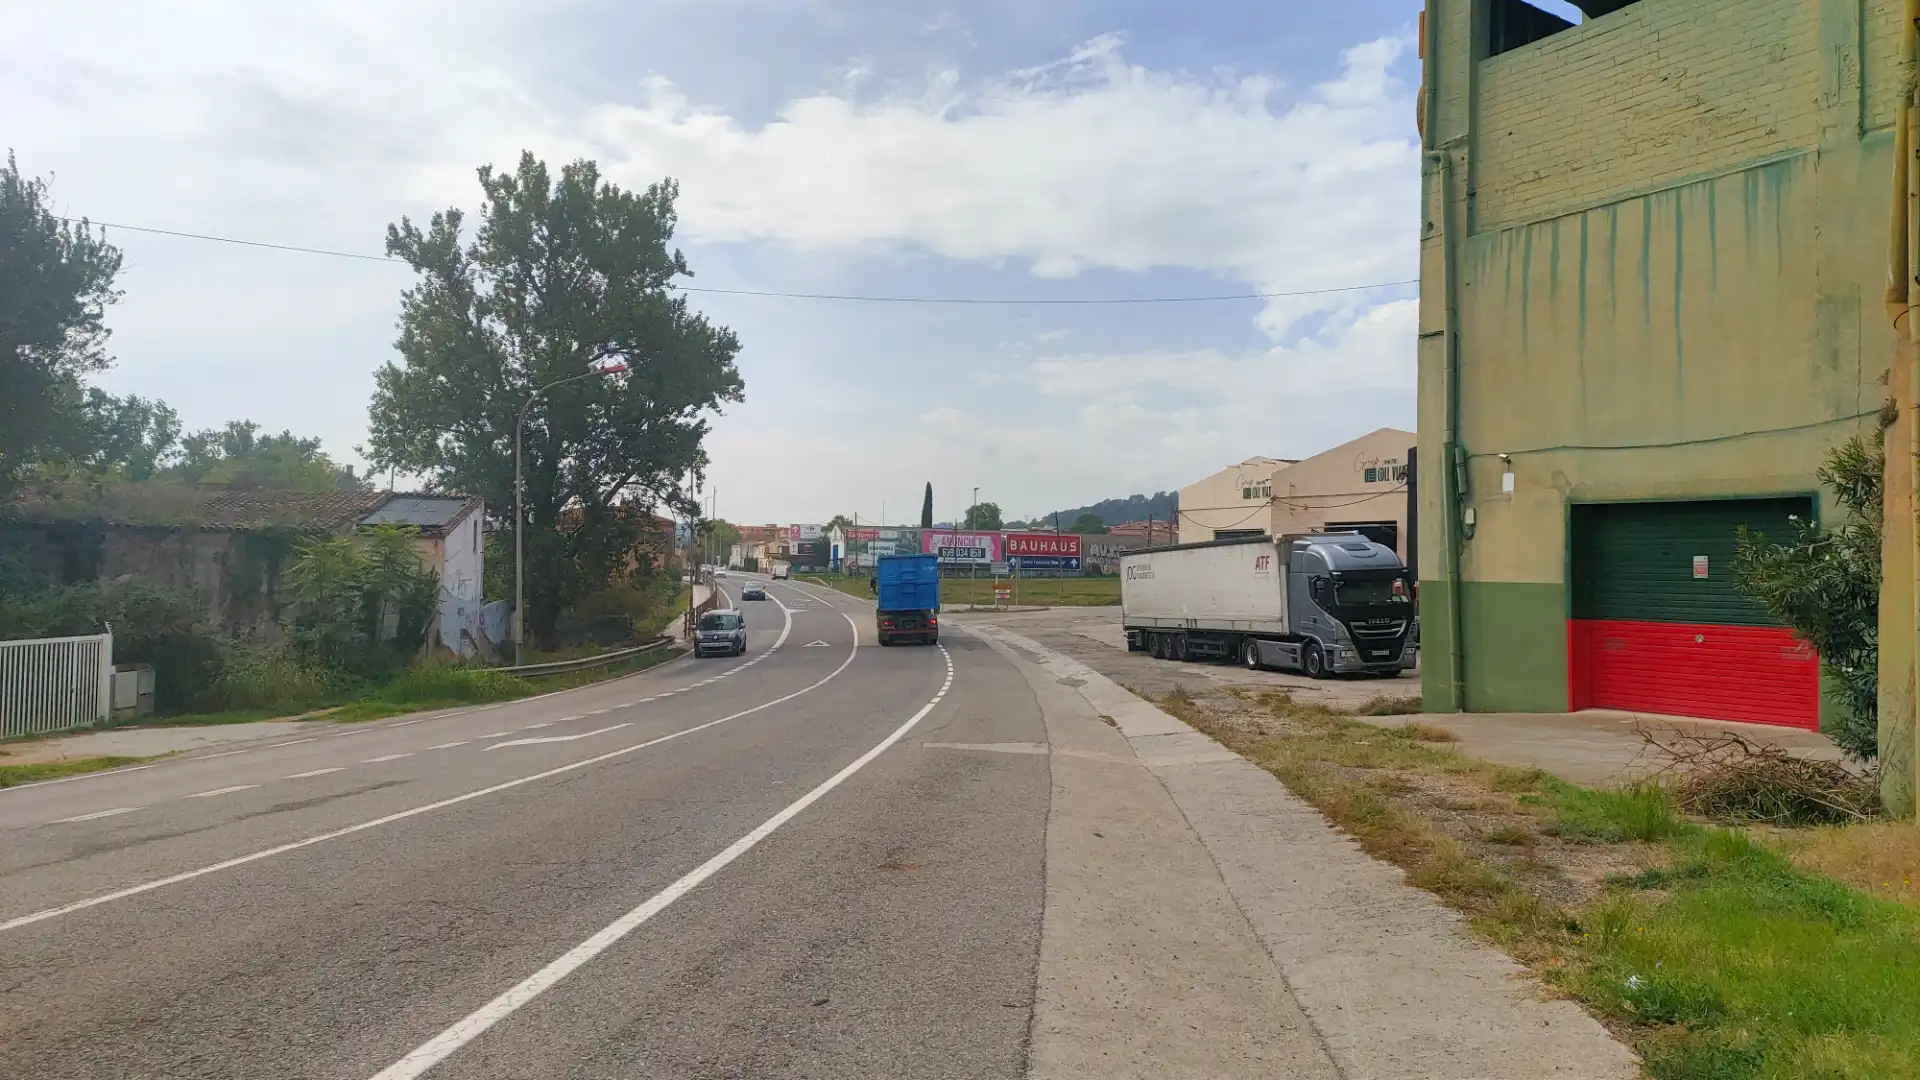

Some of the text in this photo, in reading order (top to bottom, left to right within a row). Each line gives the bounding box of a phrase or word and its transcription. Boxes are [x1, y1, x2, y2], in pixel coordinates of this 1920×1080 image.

[1010, 539, 1077, 552] BAUHAUS
[955, 548, 968, 557] 034
[1255, 555, 1270, 571] ATF
[1368, 617, 1390, 625] IVECO
